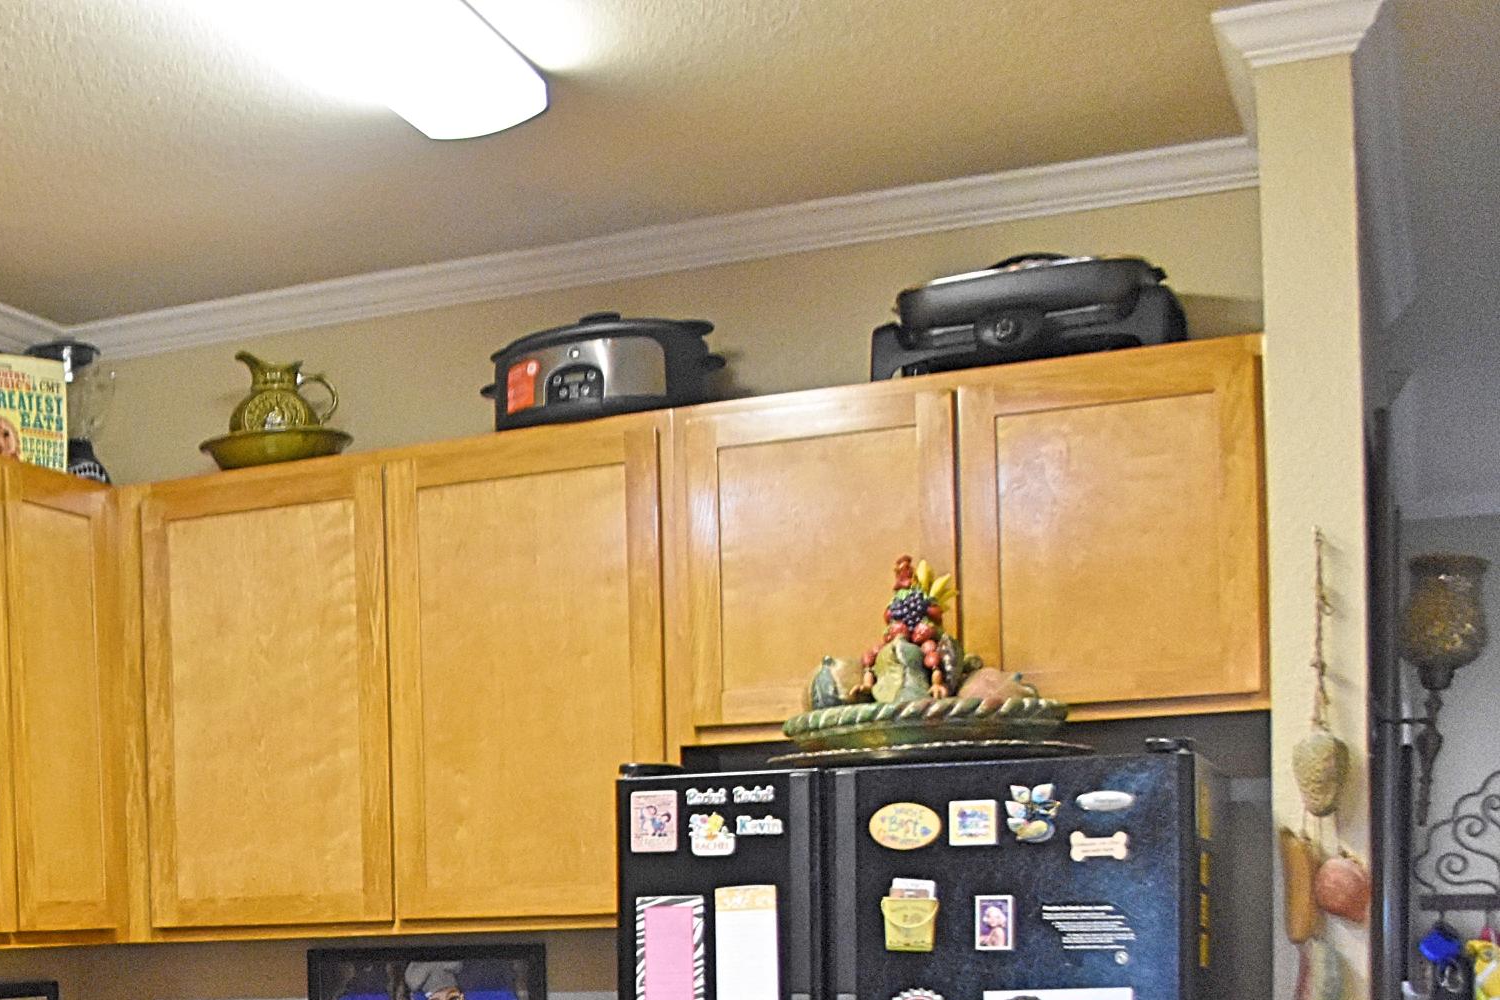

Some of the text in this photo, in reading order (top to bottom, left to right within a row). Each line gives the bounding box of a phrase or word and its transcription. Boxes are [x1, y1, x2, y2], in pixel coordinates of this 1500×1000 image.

[21, 411, 63, 432] EATS
[22, 436, 64, 457] RECIPES
[739, 817, 782, 832] Kevin
